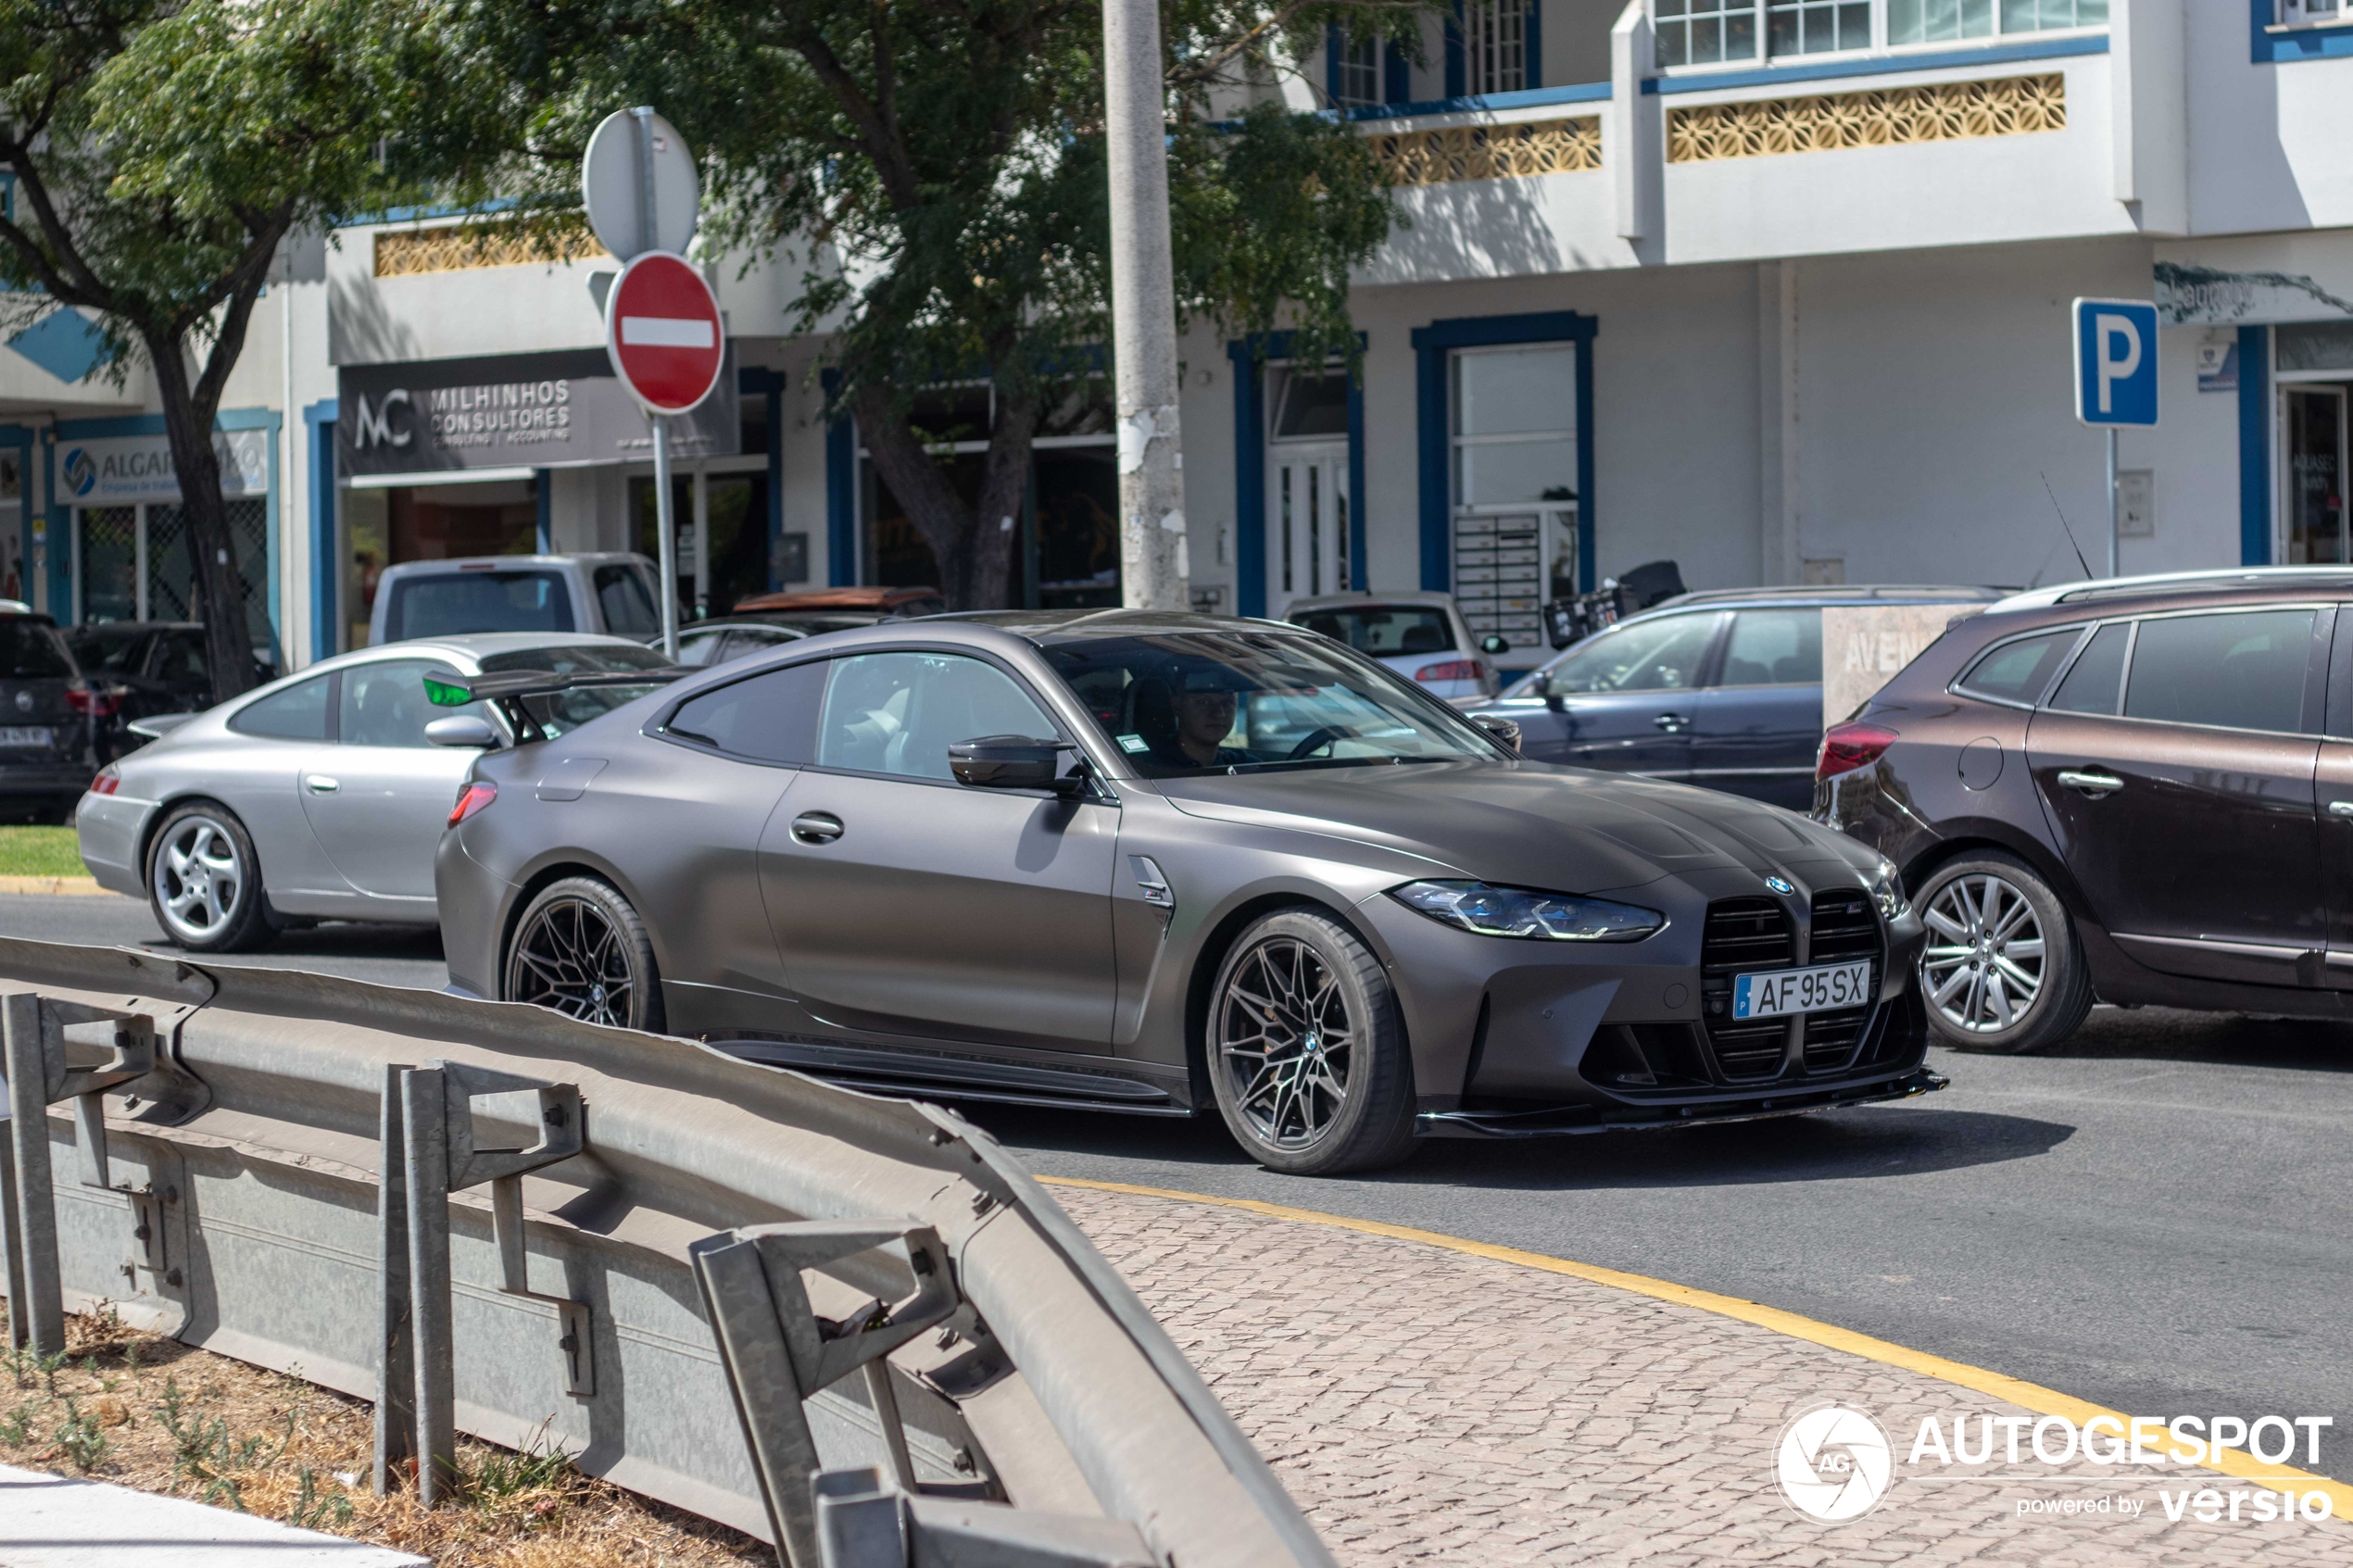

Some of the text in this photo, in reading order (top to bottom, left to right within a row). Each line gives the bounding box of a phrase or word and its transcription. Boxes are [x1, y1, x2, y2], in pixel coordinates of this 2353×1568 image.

[2170, 276, 2254, 309] Laundry
[2095, 313, 2142, 413] P
[431, 379, 570, 411] MILHINHOS
[431, 406, 571, 434] CONSULTORES
[432, 428, 571, 448] CONSULTING ACCOUNTING
